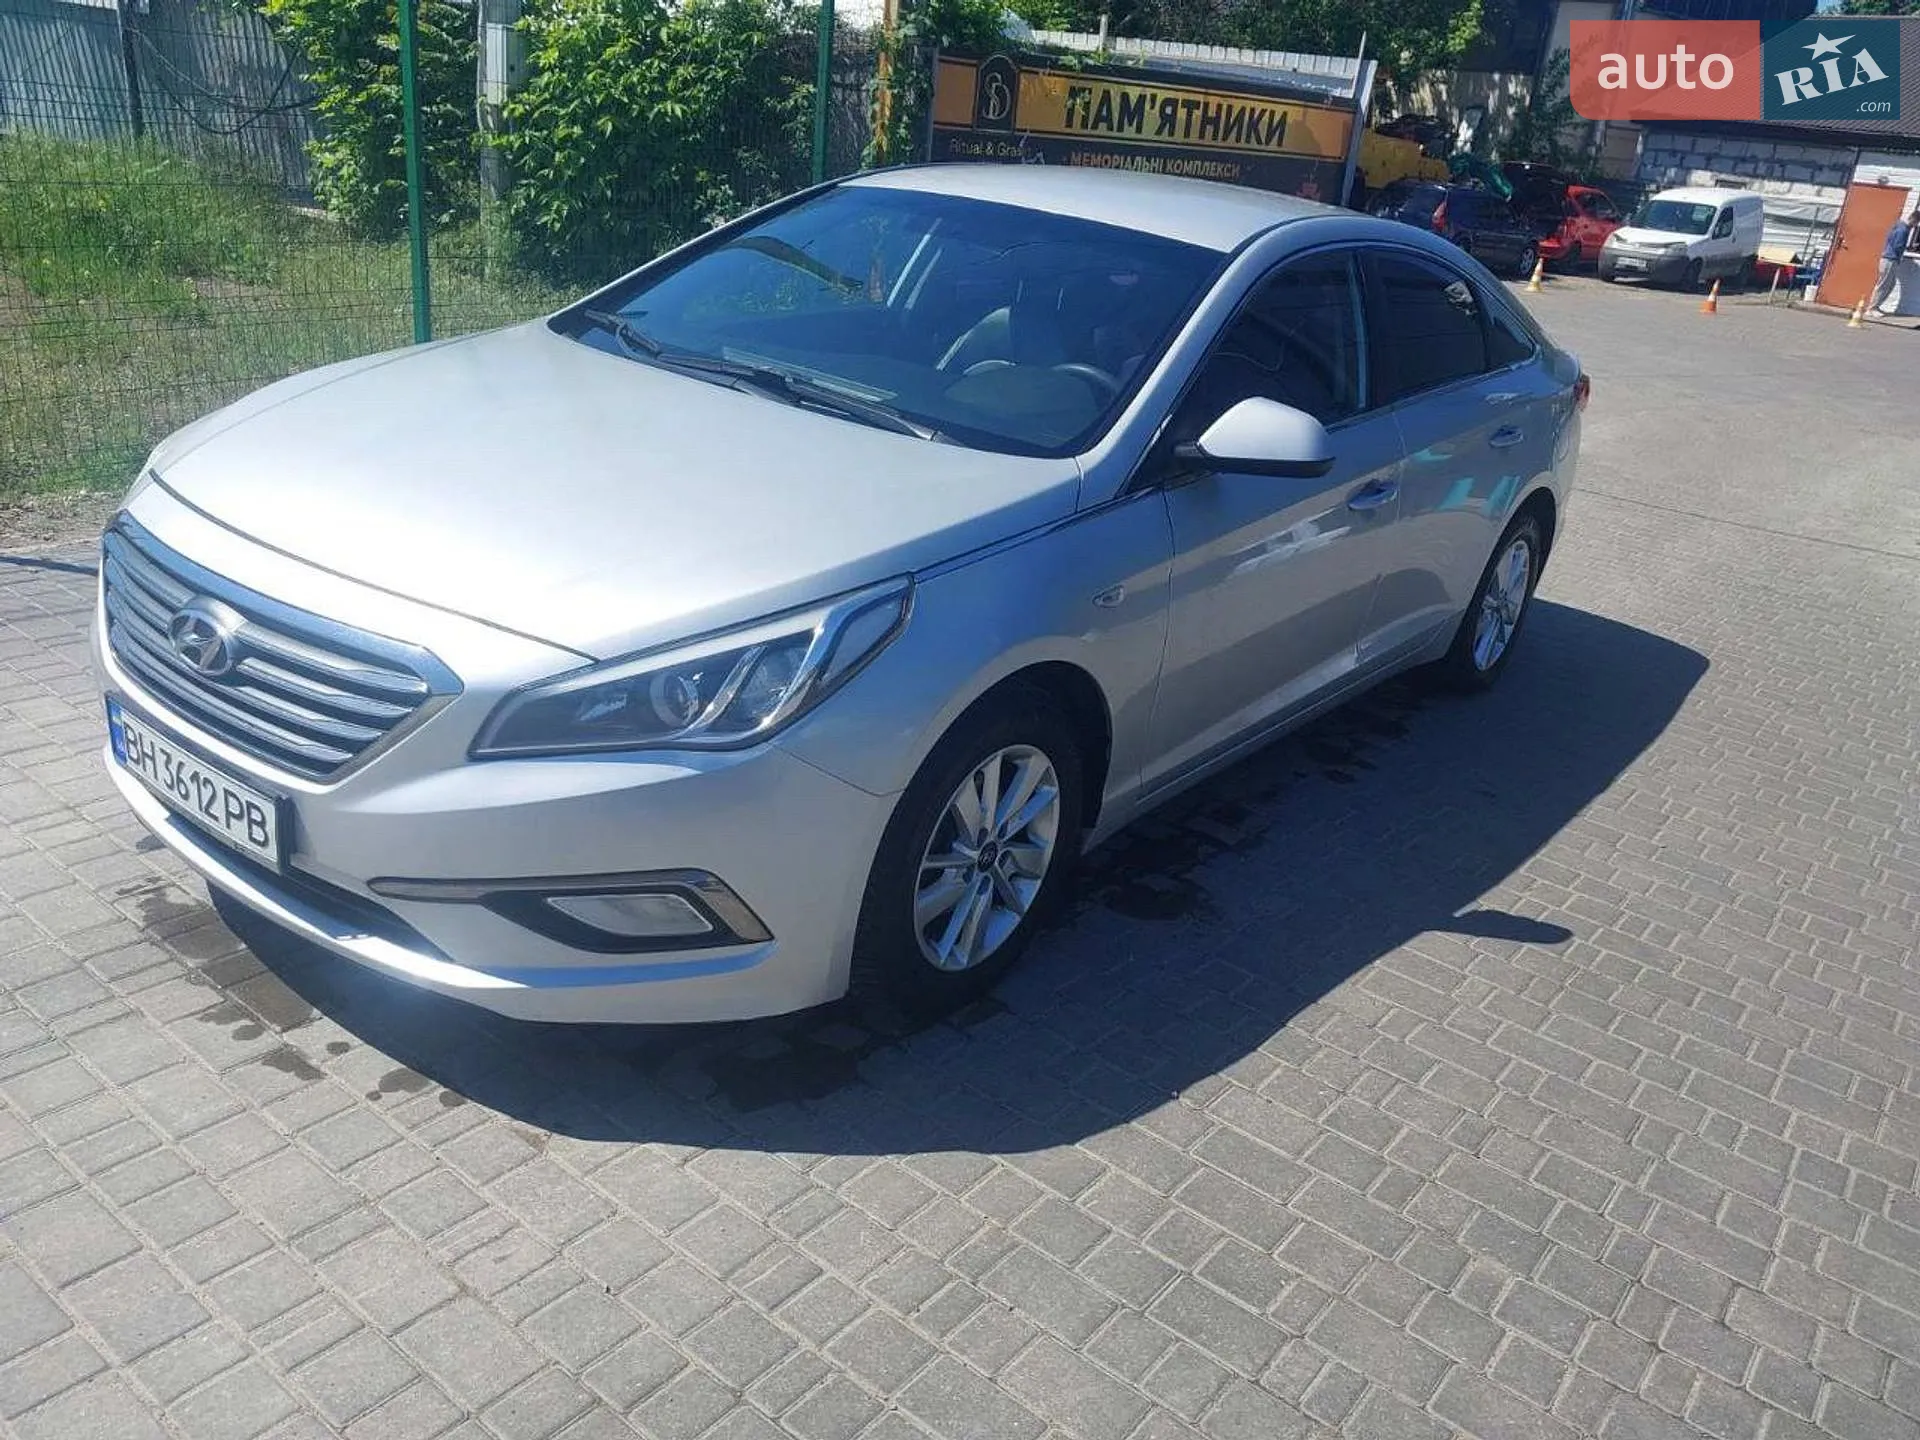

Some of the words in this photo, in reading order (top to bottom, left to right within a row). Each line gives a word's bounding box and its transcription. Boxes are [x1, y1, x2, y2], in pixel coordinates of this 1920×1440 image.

[1064, 86, 1288, 147] ПАМ'ЯТНИКИ
[1070, 152, 1162, 173] МЕМОРІАЛЬНІ
[1166, 158, 1240, 178] КОМПЛЕКСИ
